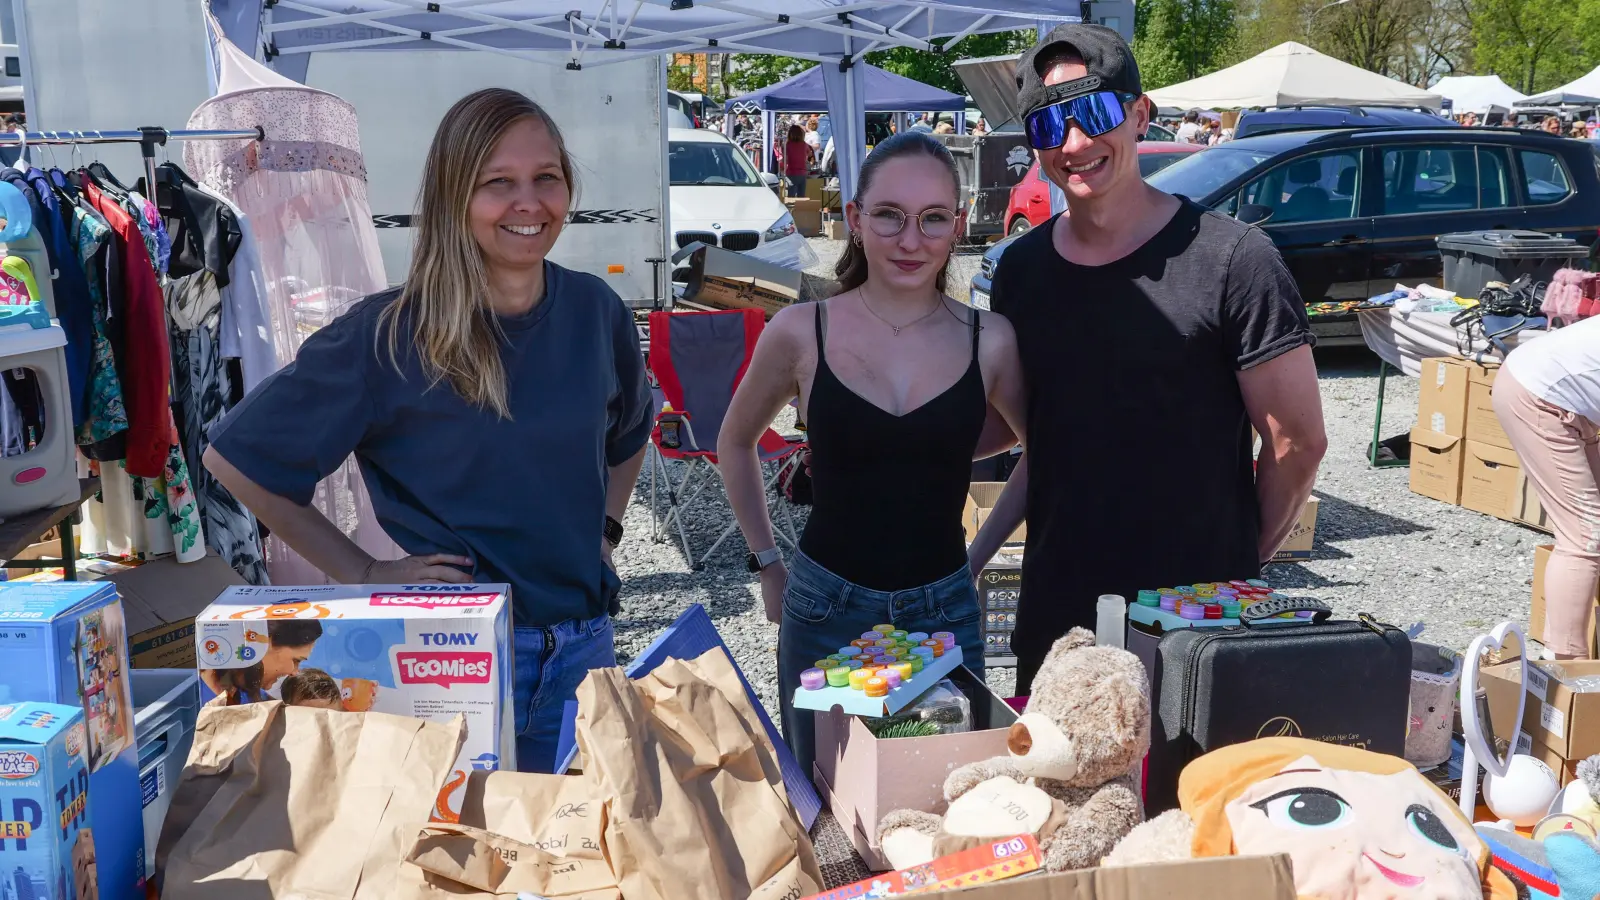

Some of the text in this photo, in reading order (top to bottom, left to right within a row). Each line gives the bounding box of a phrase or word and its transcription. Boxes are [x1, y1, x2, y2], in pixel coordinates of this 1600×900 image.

[985, 571, 1021, 584] TASS
[419, 632, 479, 646] TOMY
[0, 761, 34, 774] LACE
[62, 794, 86, 825] TOWER
[1001, 801, 1030, 821] YOU
